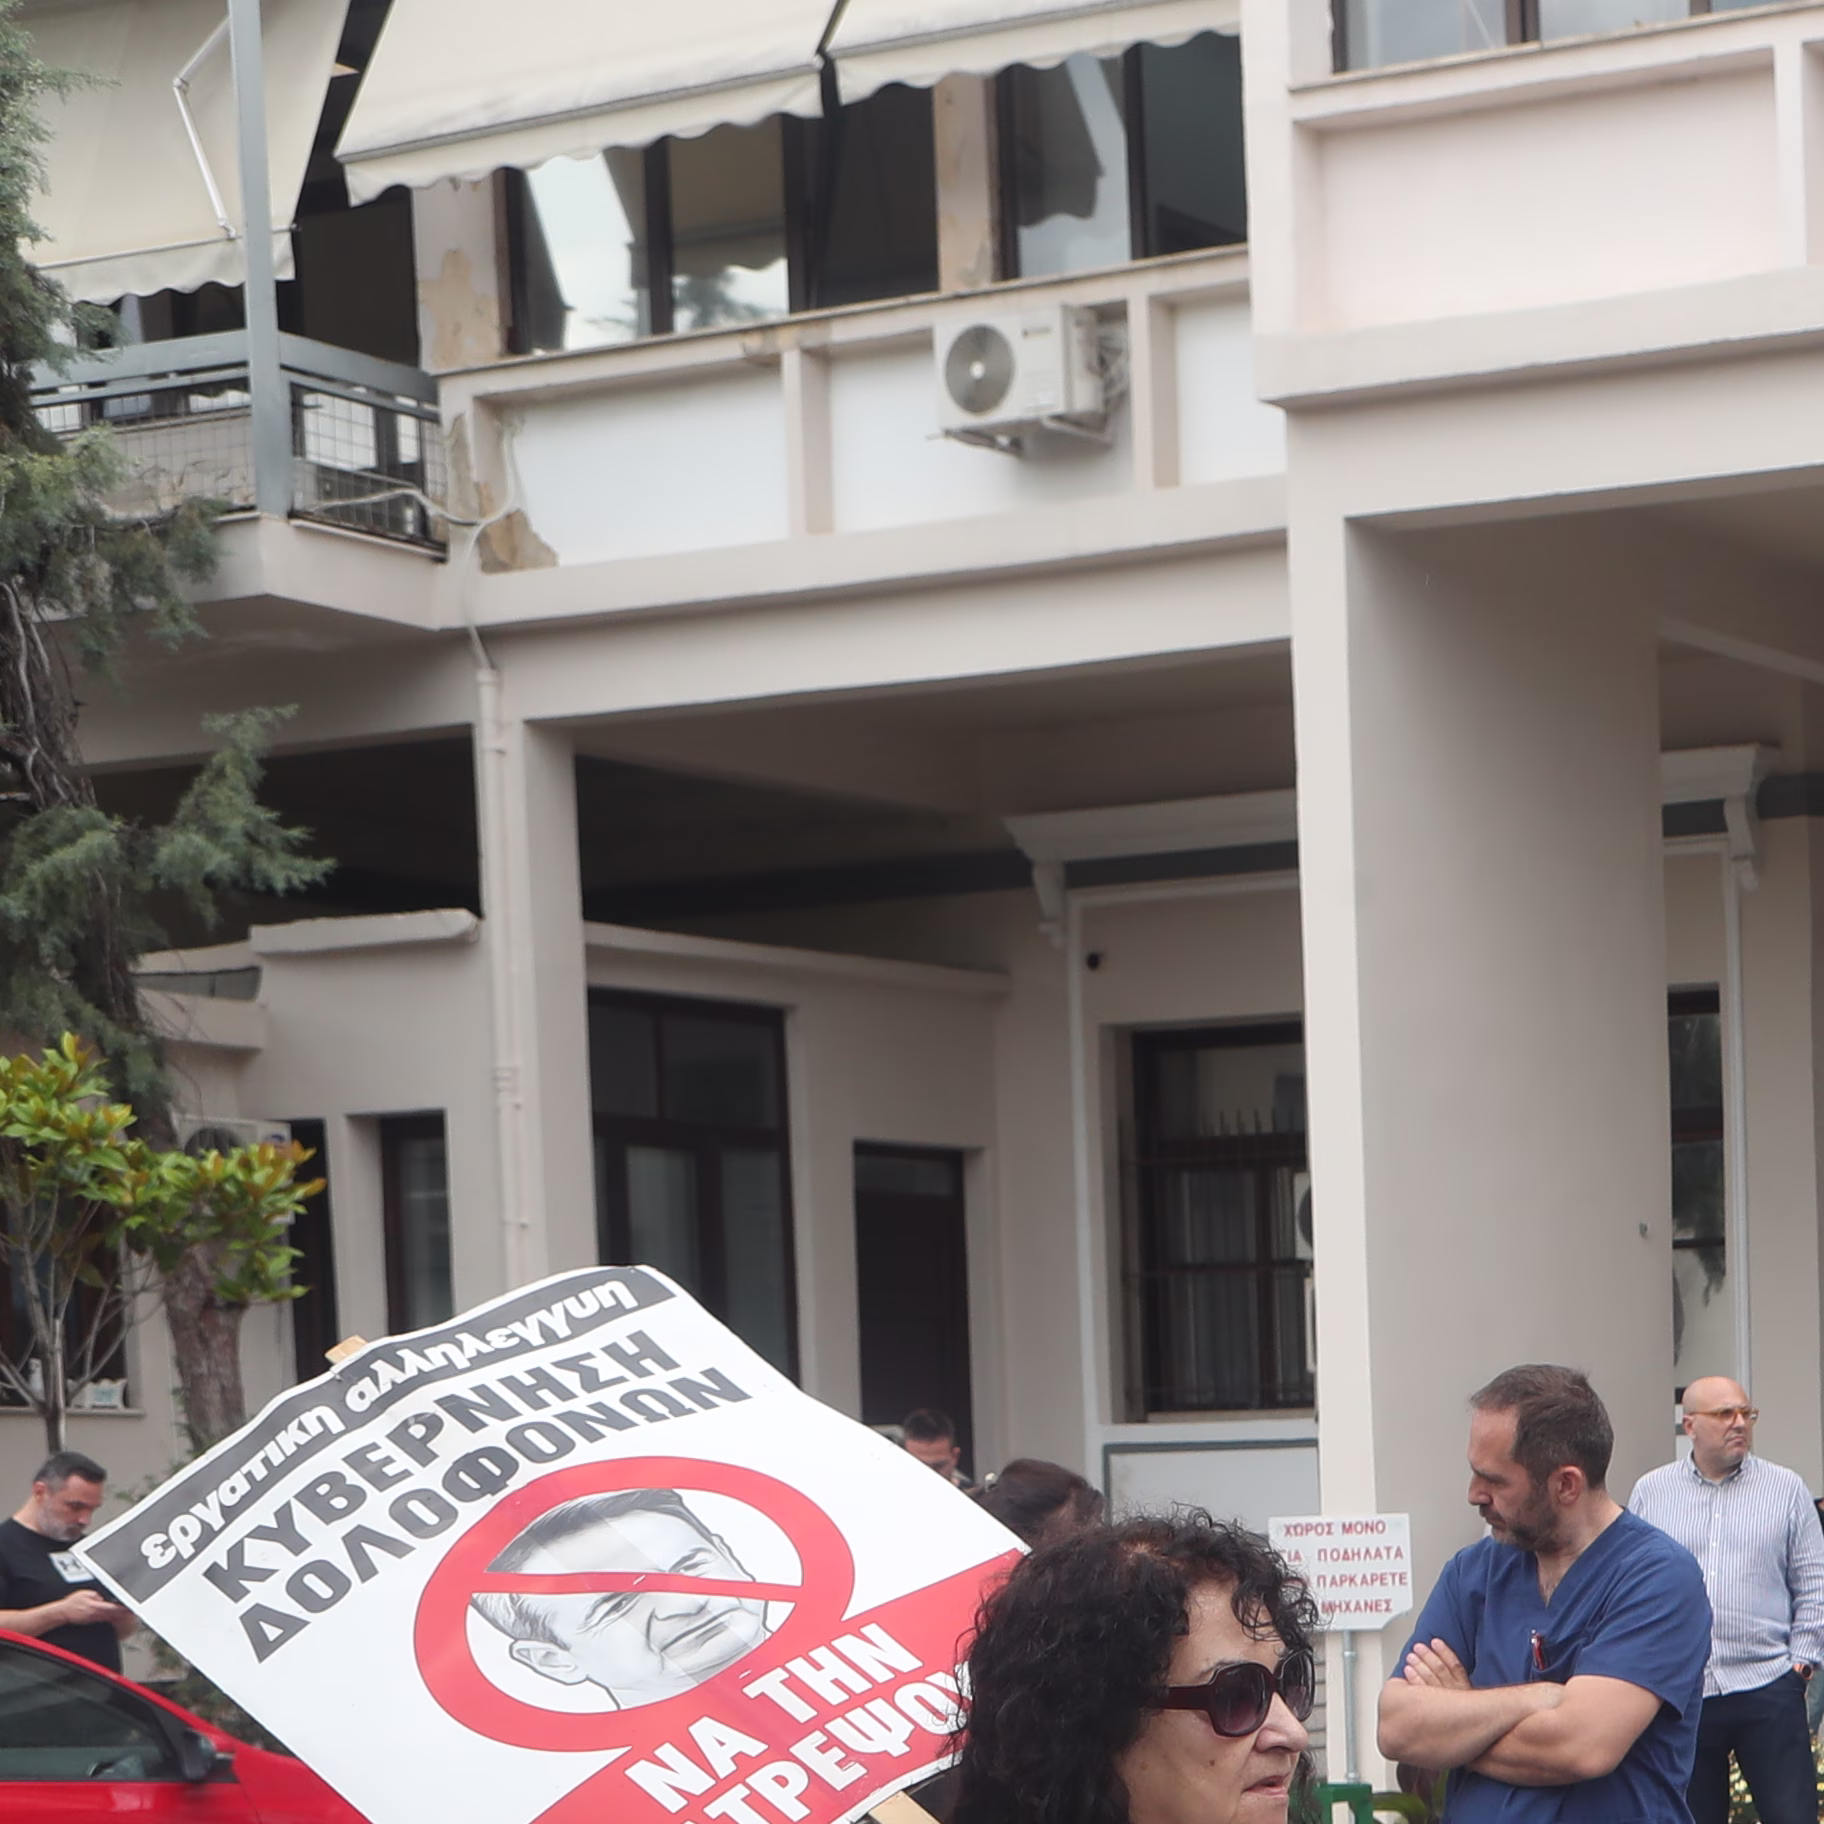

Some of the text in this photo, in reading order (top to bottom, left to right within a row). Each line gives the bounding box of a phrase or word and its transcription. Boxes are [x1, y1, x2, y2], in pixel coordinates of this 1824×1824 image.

[140, 1279, 638, 1569] εργατικη αλληλεγγυη
[203, 1330, 682, 1603] ΚΥΒΕΡΝΗΣΗ
[239, 1367, 754, 1663] ΔΟΛΟΦΟΝΩΝ
[1283, 1519, 1387, 1538] ΧΩΡΟΣ ΜΟΝΟ
[1317, 1545, 1404, 1562] ΠΟΔΗΛΑΤΑ
[1316, 1571, 1408, 1588] ΠΑΡΚΑΡΕΤΕ
[1321, 1598, 1393, 1614] ΜΗΧΑΝΕΣ
[624, 1622, 924, 1814] ΝΑ ΤΗΝ
